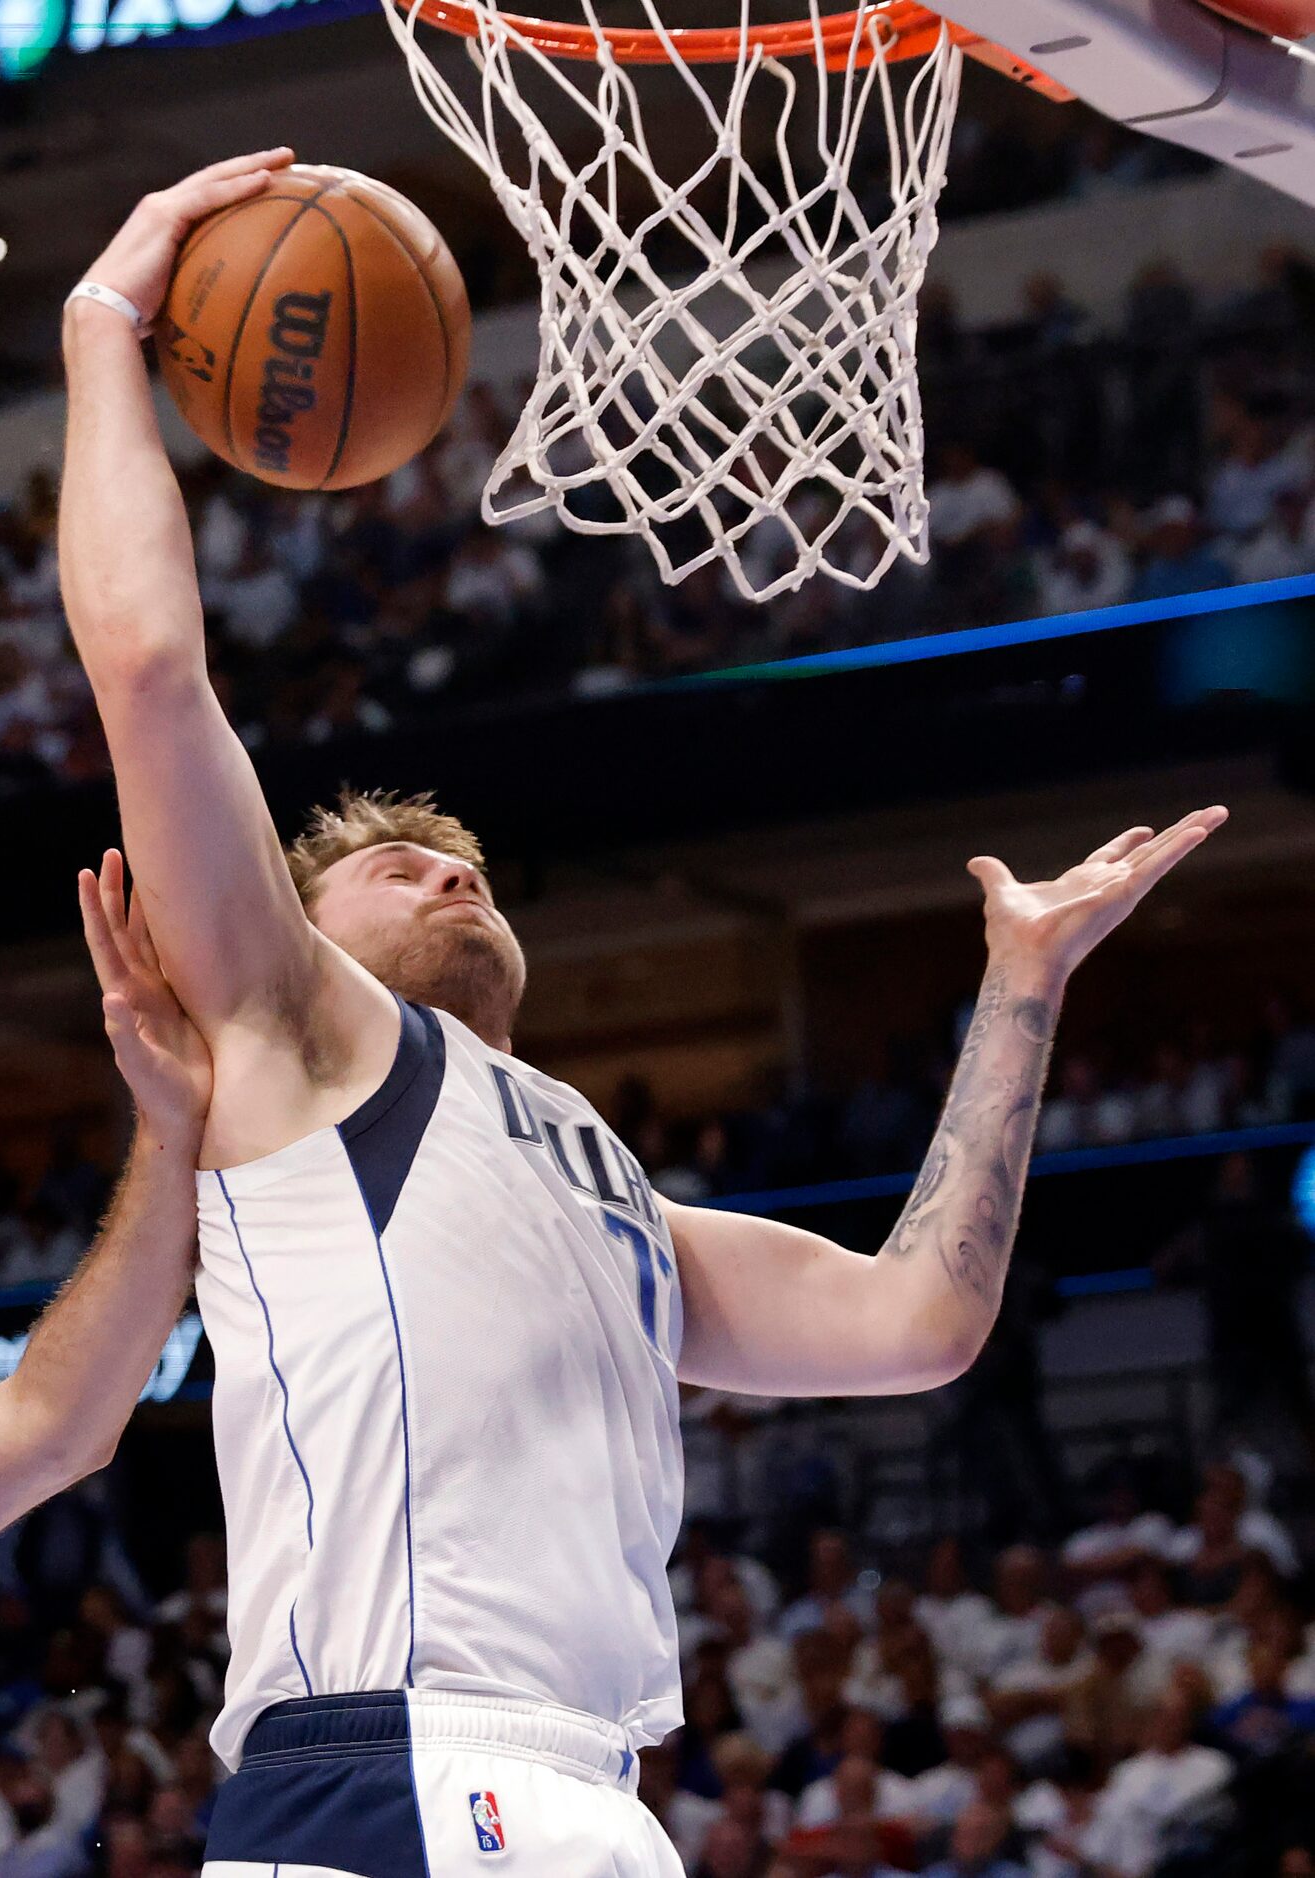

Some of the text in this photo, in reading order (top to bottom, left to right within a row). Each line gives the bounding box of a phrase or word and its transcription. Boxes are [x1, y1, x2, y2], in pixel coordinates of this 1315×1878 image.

[254, 287, 333, 473] Wilson
[602, 1208, 673, 1352] 7
[481, 1835, 493, 1848] 75
